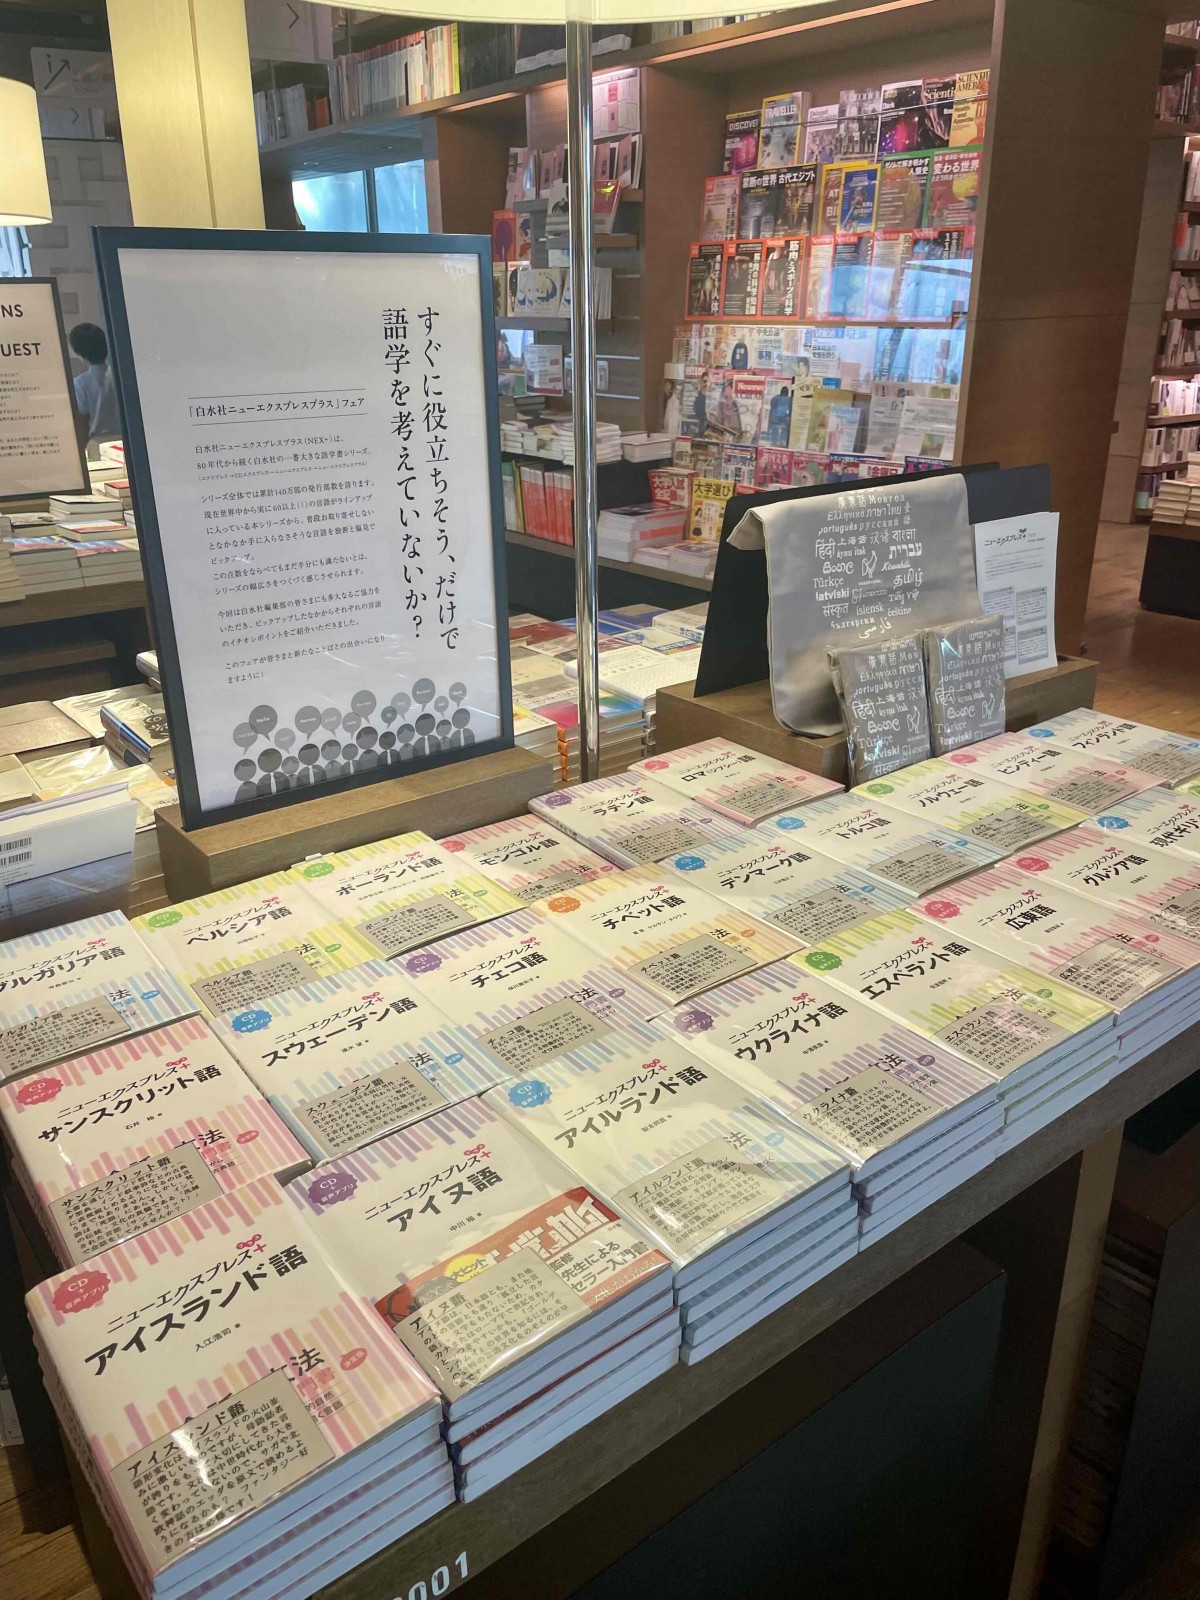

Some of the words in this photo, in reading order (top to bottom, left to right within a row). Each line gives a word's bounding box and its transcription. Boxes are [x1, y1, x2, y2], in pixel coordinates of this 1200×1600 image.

[778, 170, 816, 184] 古代エジプト
[933, 160, 980, 176] 変わる世界
[189, 398, 365, 417] 「白水社ニューエクスプレスプラス」フェア
[382, 308, 427, 638] 語学を考えていないか？
[417, 307, 460, 649] すぐに役立ちそう、だけで
[694, 482, 732, 497] 大学選び
[813, 577, 844, 589] Türkçe
[815, 588, 850, 601] latviski
[1072, 722, 1138, 749] フィンランド語
[998, 749, 1063, 775] ヒンディー語
[593, 795, 654, 816] ラテン語
[916, 778, 985, 807] ノルウェー語
[836, 817, 892, 840] トルコ語
[479, 838, 560, 867] モンゴル語
[719, 852, 812, 889] デンマーク語
[1083, 854, 1149, 887] グルジア語
[336, 857, 443, 897] ポーランド語
[187, 906, 292, 945] ペルシア語
[602, 894, 686, 931] チベット語
[1004, 904, 1057, 931] 広東語
[471, 951, 548, 989] チェコ語
[859, 941, 971, 1001] エスペラント語
[241, 1013, 256, 1023] CD
[261, 997, 419, 1067] スウェーデン語
[734, 1002, 849, 1061] ウクライナ語
[28, 1081, 46, 1093] CD
[38, 1064, 222, 1143] サンスクリット語
[304, 1078, 383, 1114] スウェーデン語
[798, 1087, 858, 1120] ウクライナ語
[554, 1065, 709, 1149] アイルランド語
[61, 1156, 170, 1209] サンスクリット語
[319, 1177, 337, 1189] CD
[628, 1157, 705, 1203] アイルランド語
[387, 1166, 503, 1232] アイヌ語
[561, 1241, 621, 1282] 先生による
[64, 1284, 105, 1310] 音声アプリ
[66, 1277, 88, 1293] CD
[84, 1244, 309, 1376] アイスランド語
[408, 1292, 466, 1330] アイヌ語
[132, 1396, 279, 1488] 語形変化はイスランドの火山並
[392, 1551, 468, 1600] 001
